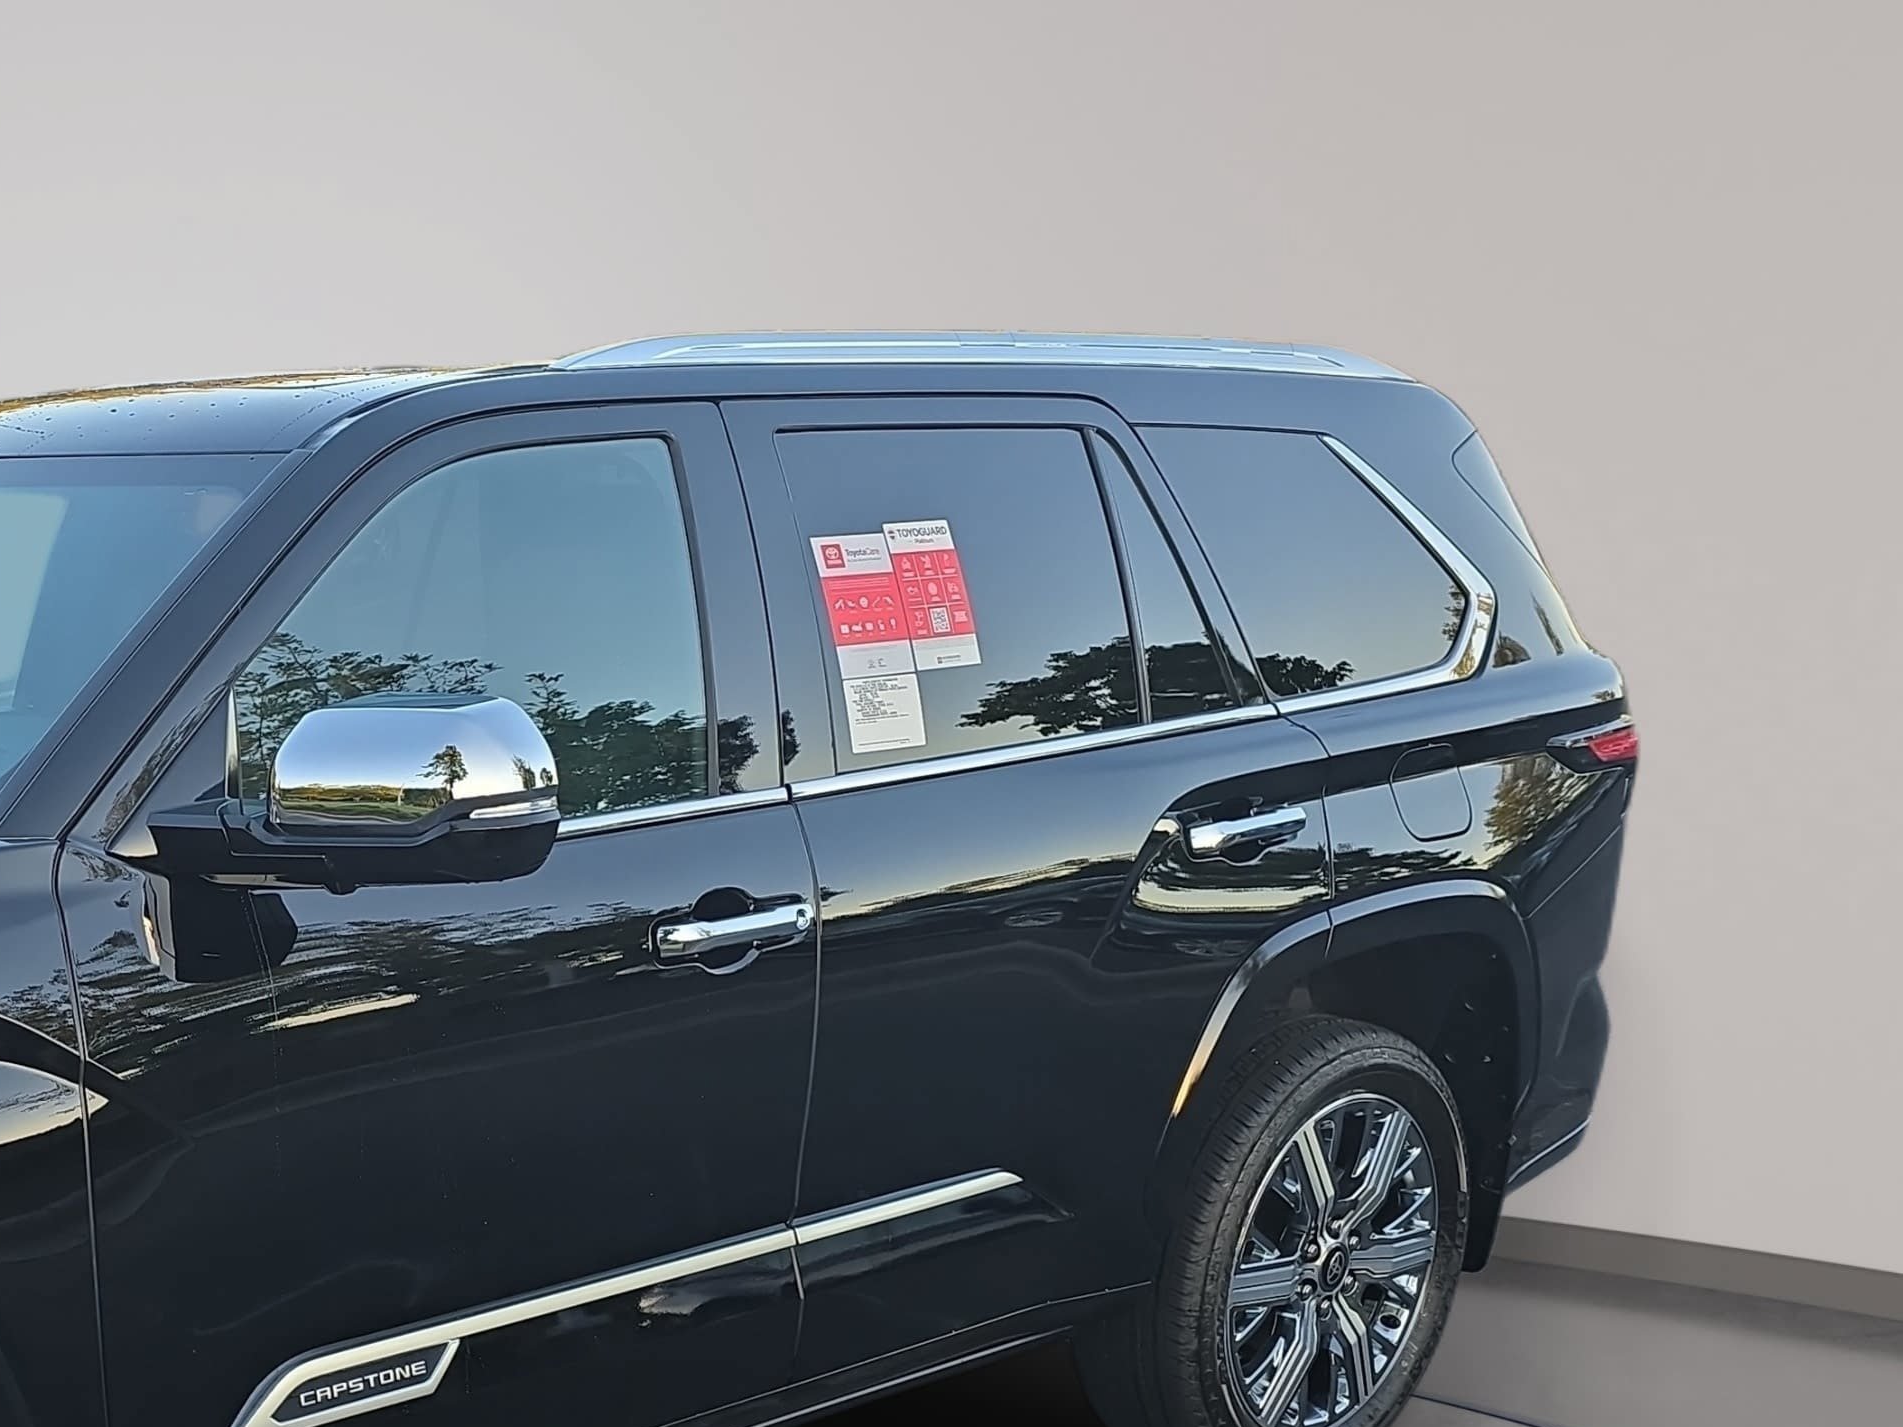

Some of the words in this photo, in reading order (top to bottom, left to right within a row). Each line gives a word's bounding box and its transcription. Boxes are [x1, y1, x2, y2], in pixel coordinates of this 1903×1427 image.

[896, 526, 947, 538] TOYOGUARD
[845, 547, 880, 558] ToyotaCare
[300, 1360, 427, 1407] CAPSTONE
